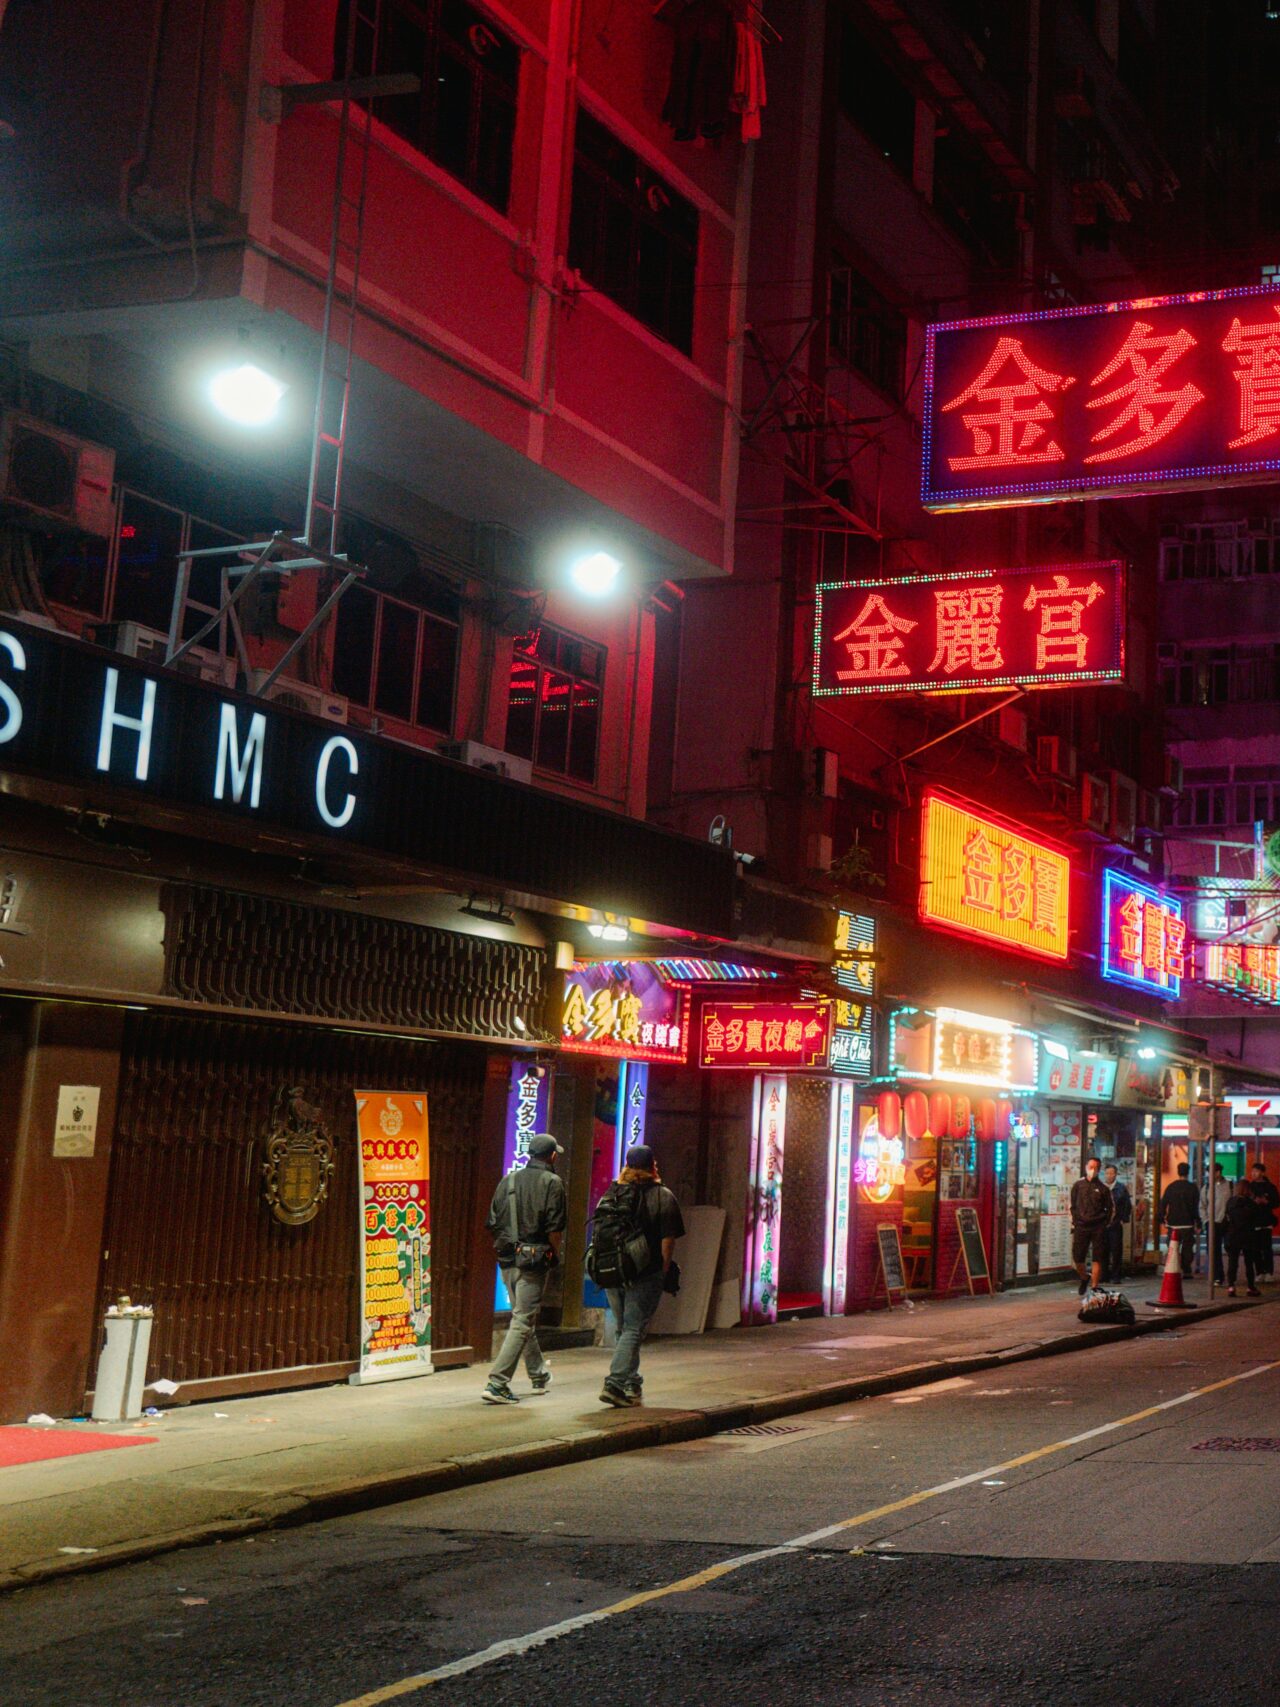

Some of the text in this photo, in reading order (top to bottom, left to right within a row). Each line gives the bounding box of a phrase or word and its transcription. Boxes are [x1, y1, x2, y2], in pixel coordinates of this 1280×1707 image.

[833, 575, 1105, 681] 金麗宮
[962, 829, 1062, 938] 金多寶
[831, 1036, 871, 1064] ight Club
[506, 1071, 541, 1176] 金多寶
